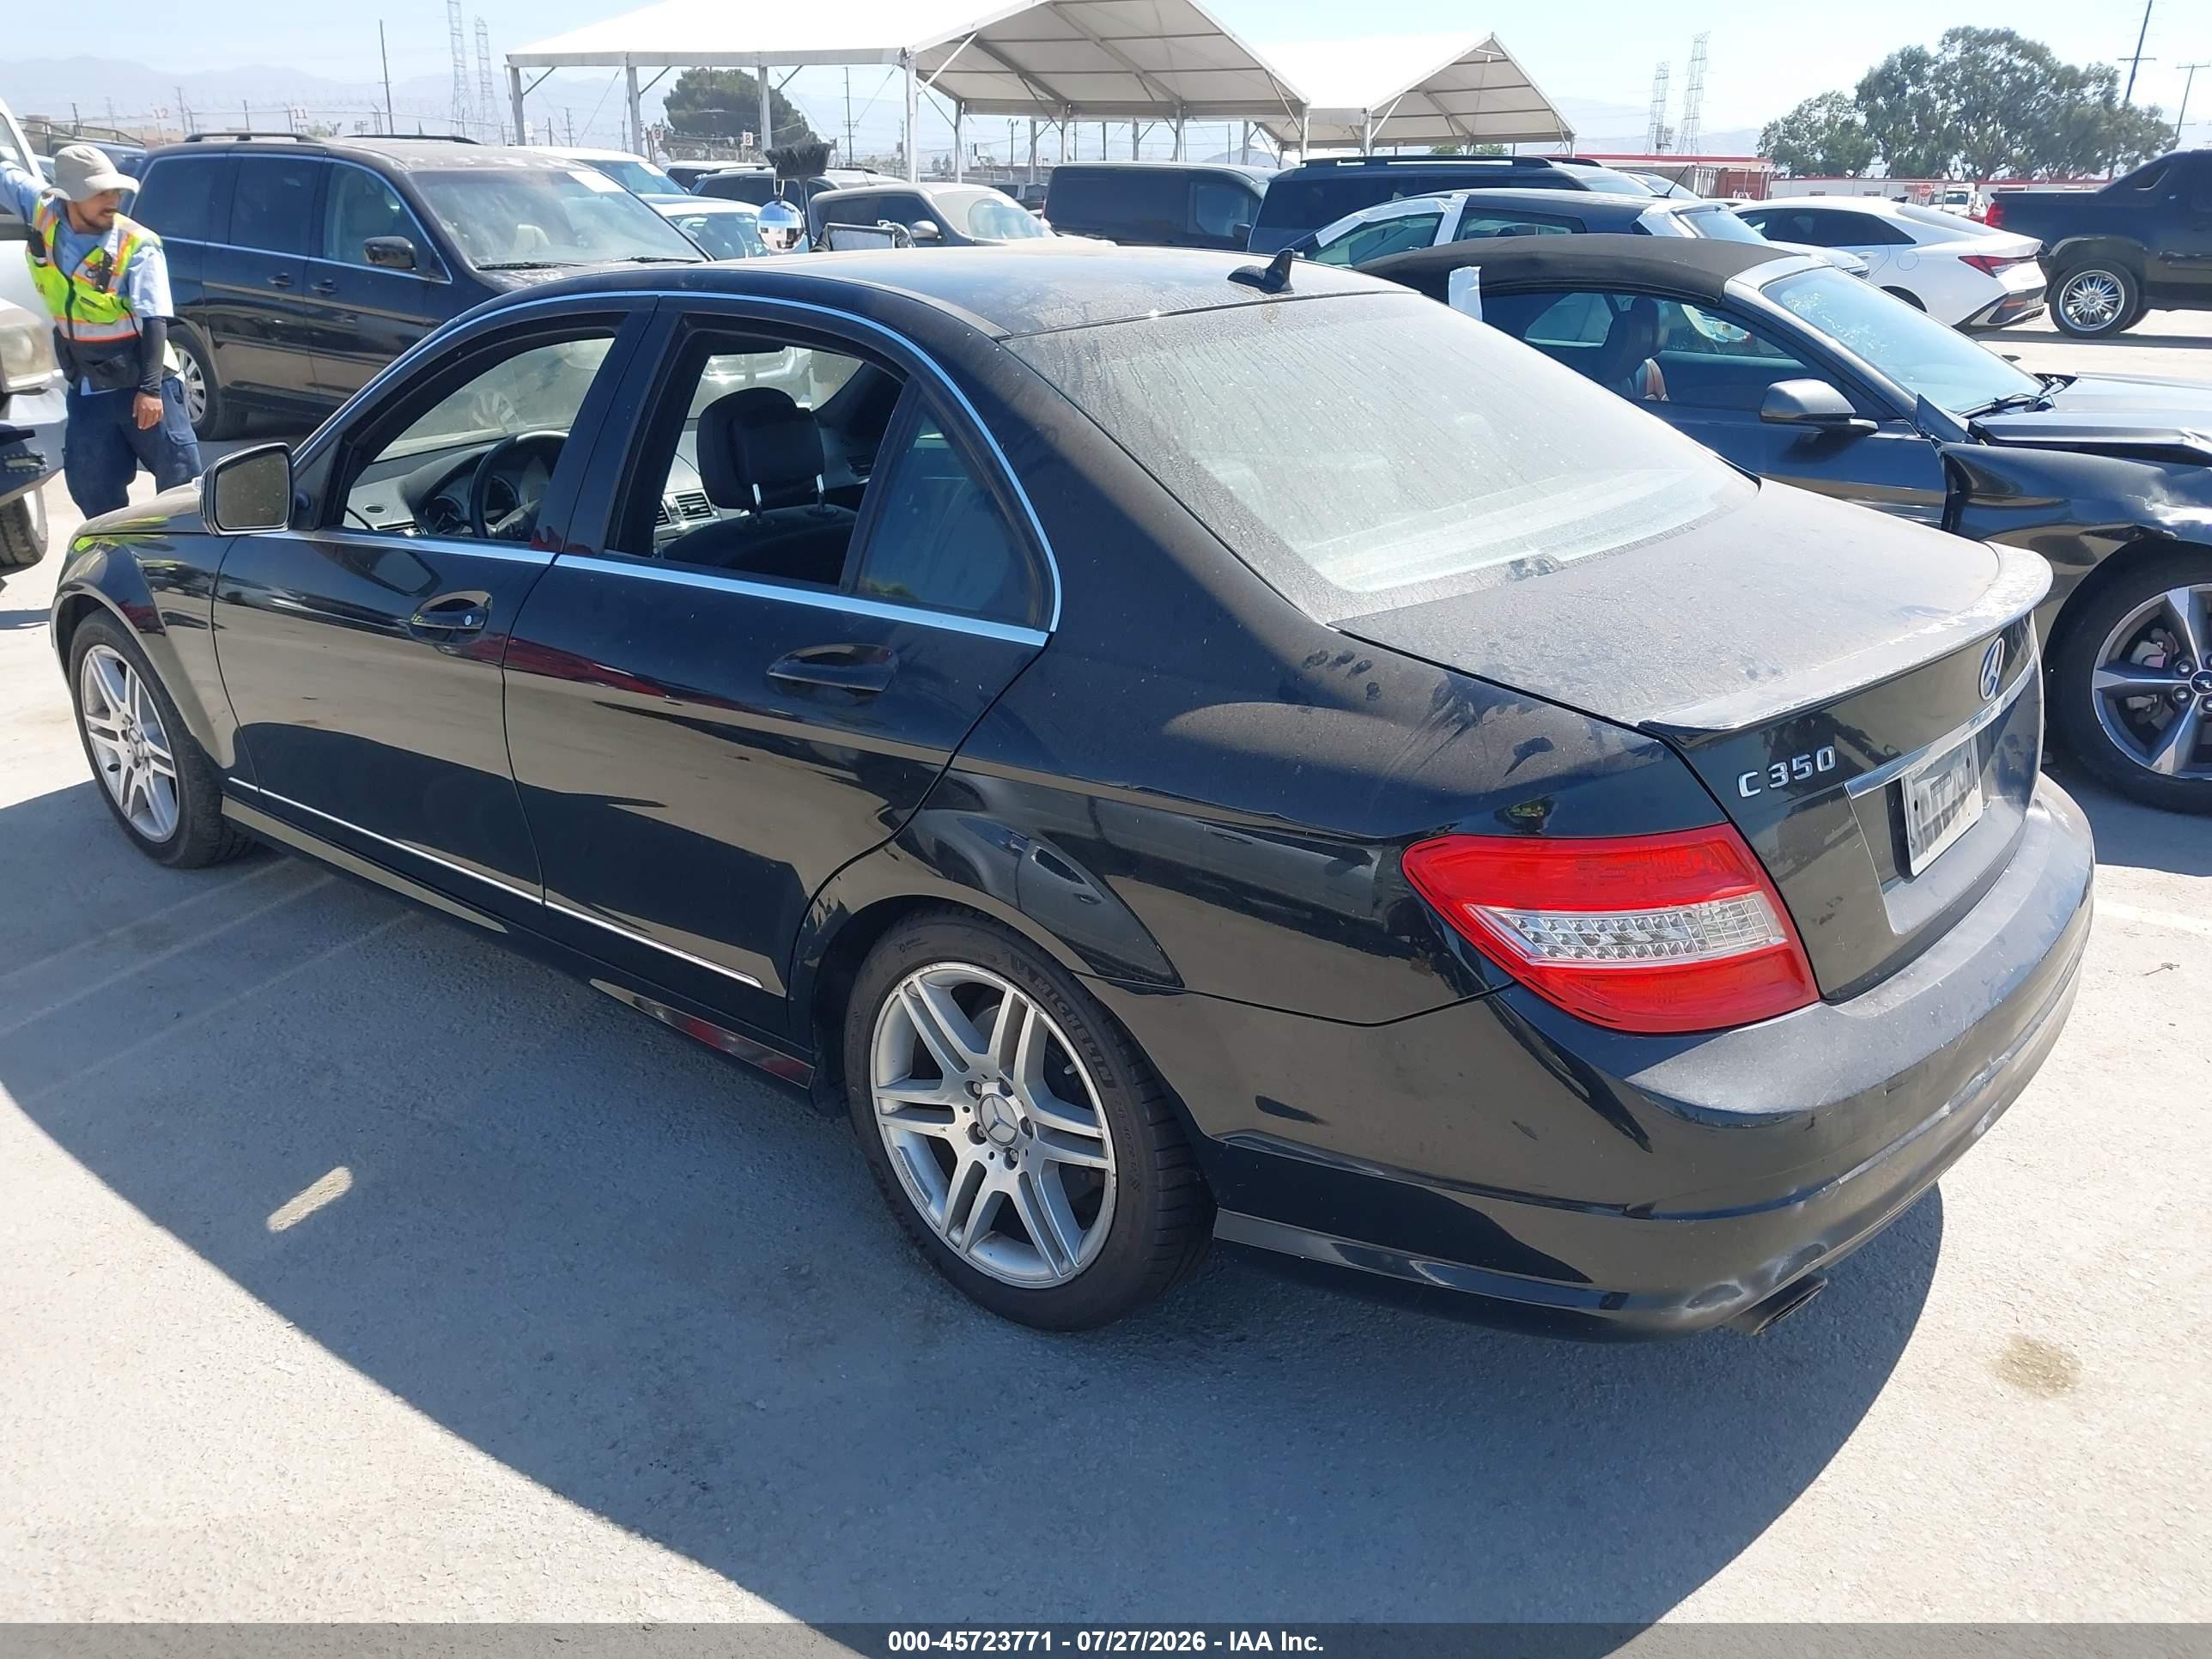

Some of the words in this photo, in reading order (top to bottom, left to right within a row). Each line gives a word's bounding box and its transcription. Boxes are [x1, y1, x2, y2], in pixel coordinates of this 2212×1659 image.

[154, 109, 168, 119] 12
[294, 108, 308, 119] 11
[745, 133, 751, 144] 8
[1732, 189, 1753, 199] tex
[1737, 771, 1762, 798] C
[1767, 744, 1837, 789] 350
[1032, 976, 1115, 1082] MICHELIN
